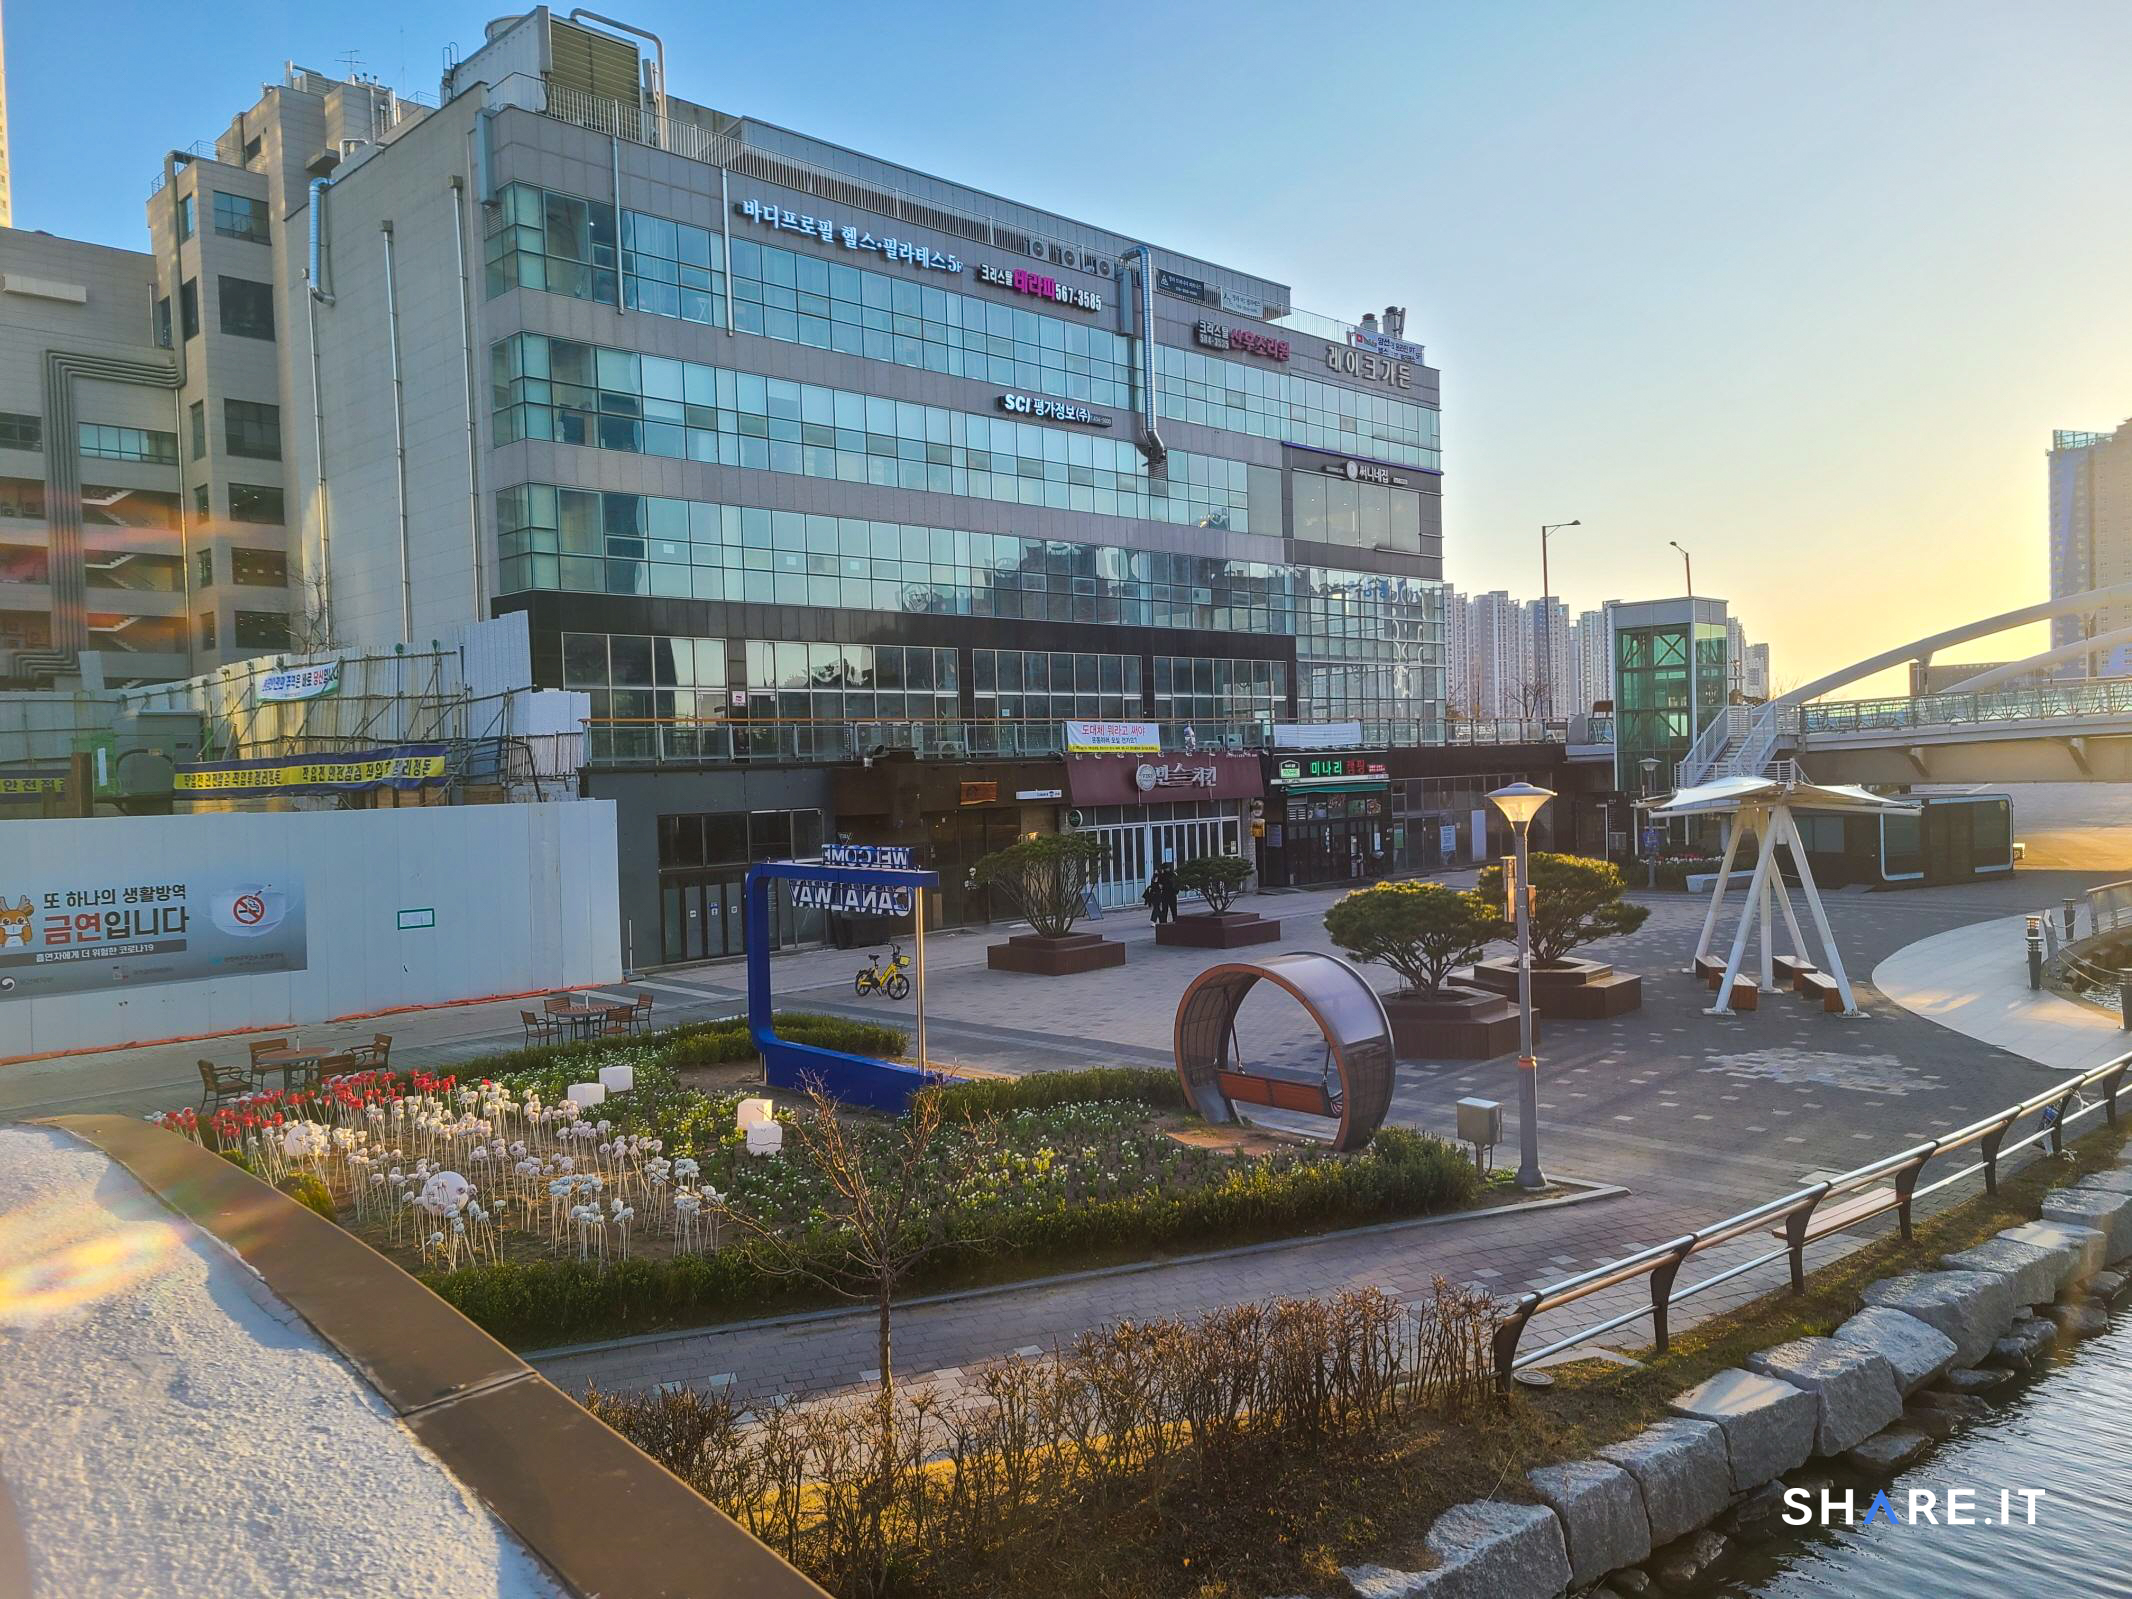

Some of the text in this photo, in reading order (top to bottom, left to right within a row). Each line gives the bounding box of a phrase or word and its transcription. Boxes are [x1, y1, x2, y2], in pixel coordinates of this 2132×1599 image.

[742, 199, 834, 243] 바디프로필
[1056, 283, 1102, 312] 567-3585
[1326, 345, 1411, 390] 레이크가든
[1004, 394, 1031, 414] SCI
[1311, 760, 1342, 776] 미나리
[43, 883, 187, 909] 또 하나의 생활방역
[43, 905, 190, 945] 금연입니다
[81, 950, 90, 959] 더
[118, 943, 155, 956] 코로나19
